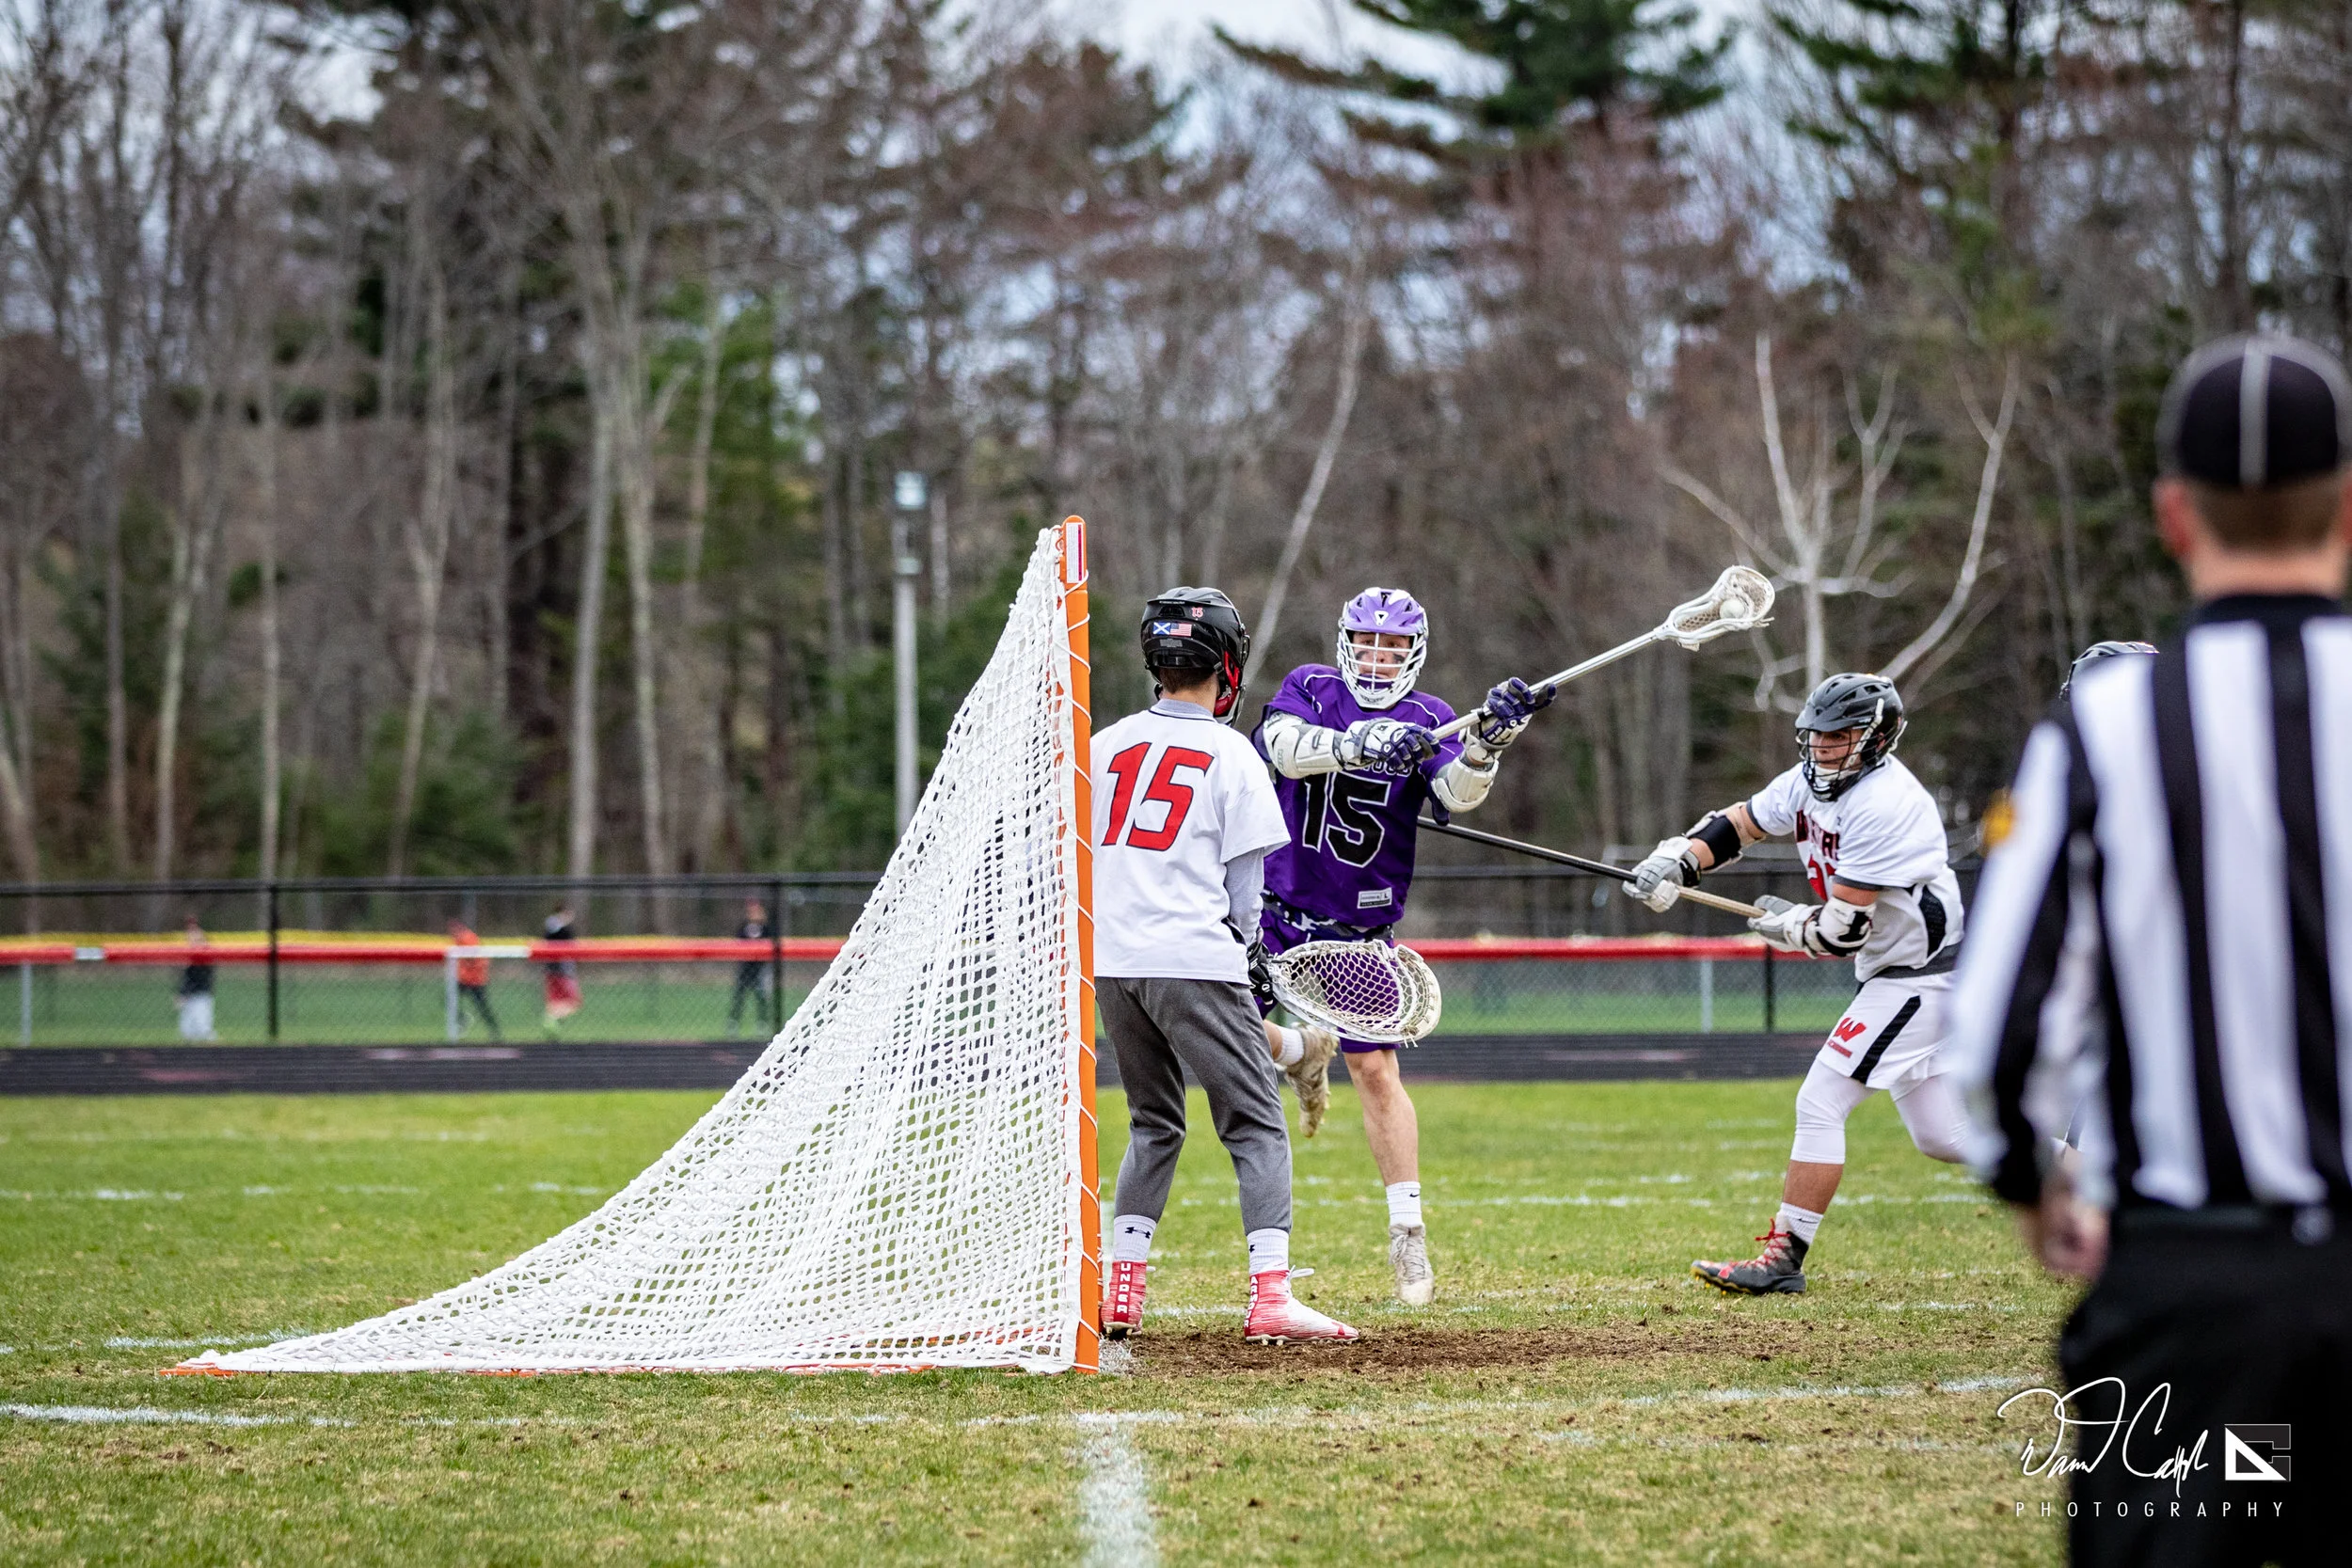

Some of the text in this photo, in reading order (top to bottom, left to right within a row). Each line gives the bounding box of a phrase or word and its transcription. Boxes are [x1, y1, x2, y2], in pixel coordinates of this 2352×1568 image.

[1102, 741, 1215, 851] 15
[1303, 771, 1392, 868] 15
[1834, 1017, 1867, 1042] W
[1116, 1262, 1132, 1314] UNDER
[1244, 1275, 1259, 1328] ARMOUR
